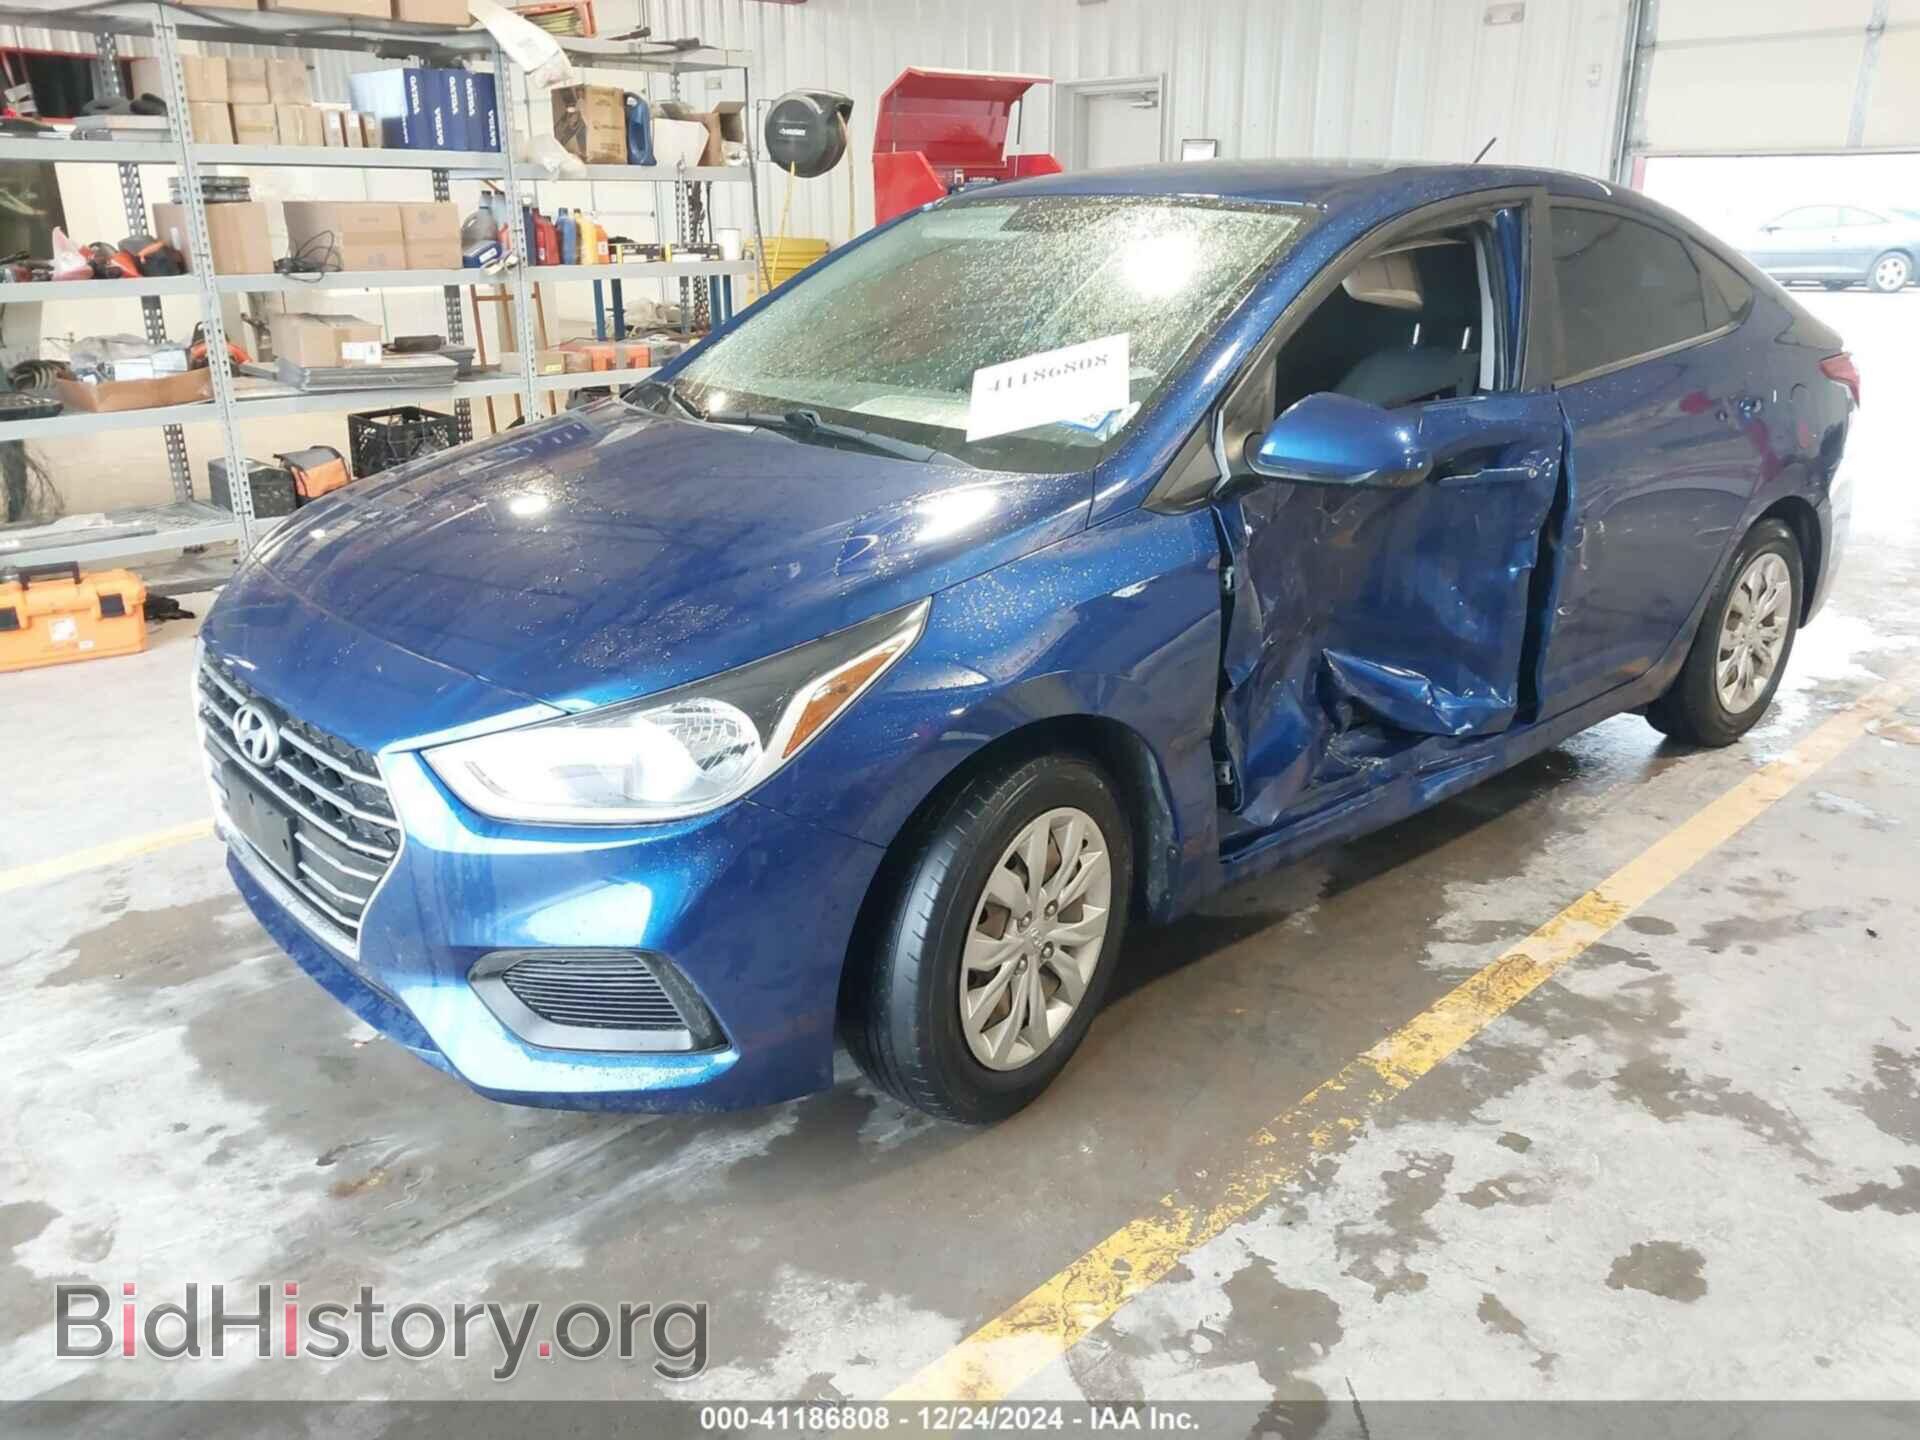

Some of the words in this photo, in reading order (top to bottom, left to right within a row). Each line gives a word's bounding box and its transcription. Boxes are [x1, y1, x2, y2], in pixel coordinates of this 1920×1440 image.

[410, 75, 420, 115] VOLVO
[449, 75, 458, 115] VOLVO
[465, 77, 475, 117] VOLVO
[434, 106, 444, 146] VOLVO
[488, 109, 497, 146] VOLVO
[987, 354, 1108, 392] 41186808
